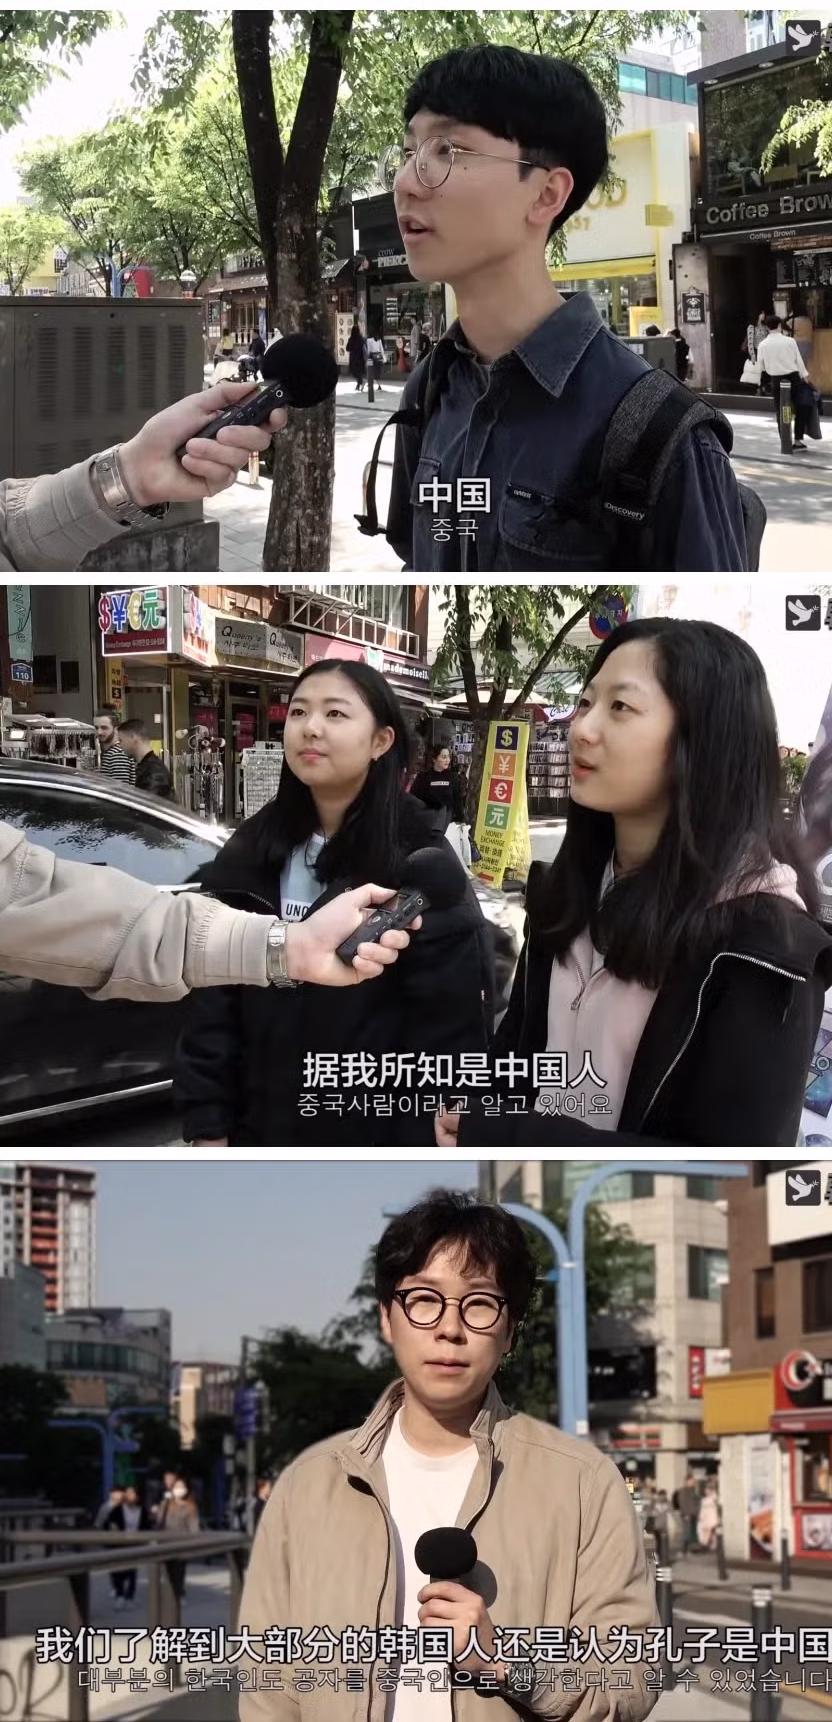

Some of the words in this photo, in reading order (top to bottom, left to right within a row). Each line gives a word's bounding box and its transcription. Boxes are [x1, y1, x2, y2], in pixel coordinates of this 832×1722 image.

[706, 201, 769, 225] Coffee
[749, 232, 772, 240] Coffee
[773, 228, 796, 238] Brown
[603, 501, 645, 521] Discovery
[15, 671, 29, 680] 110
[484, 829, 504, 839] MONEY
[480, 835, 506, 847] EXCHANGE
